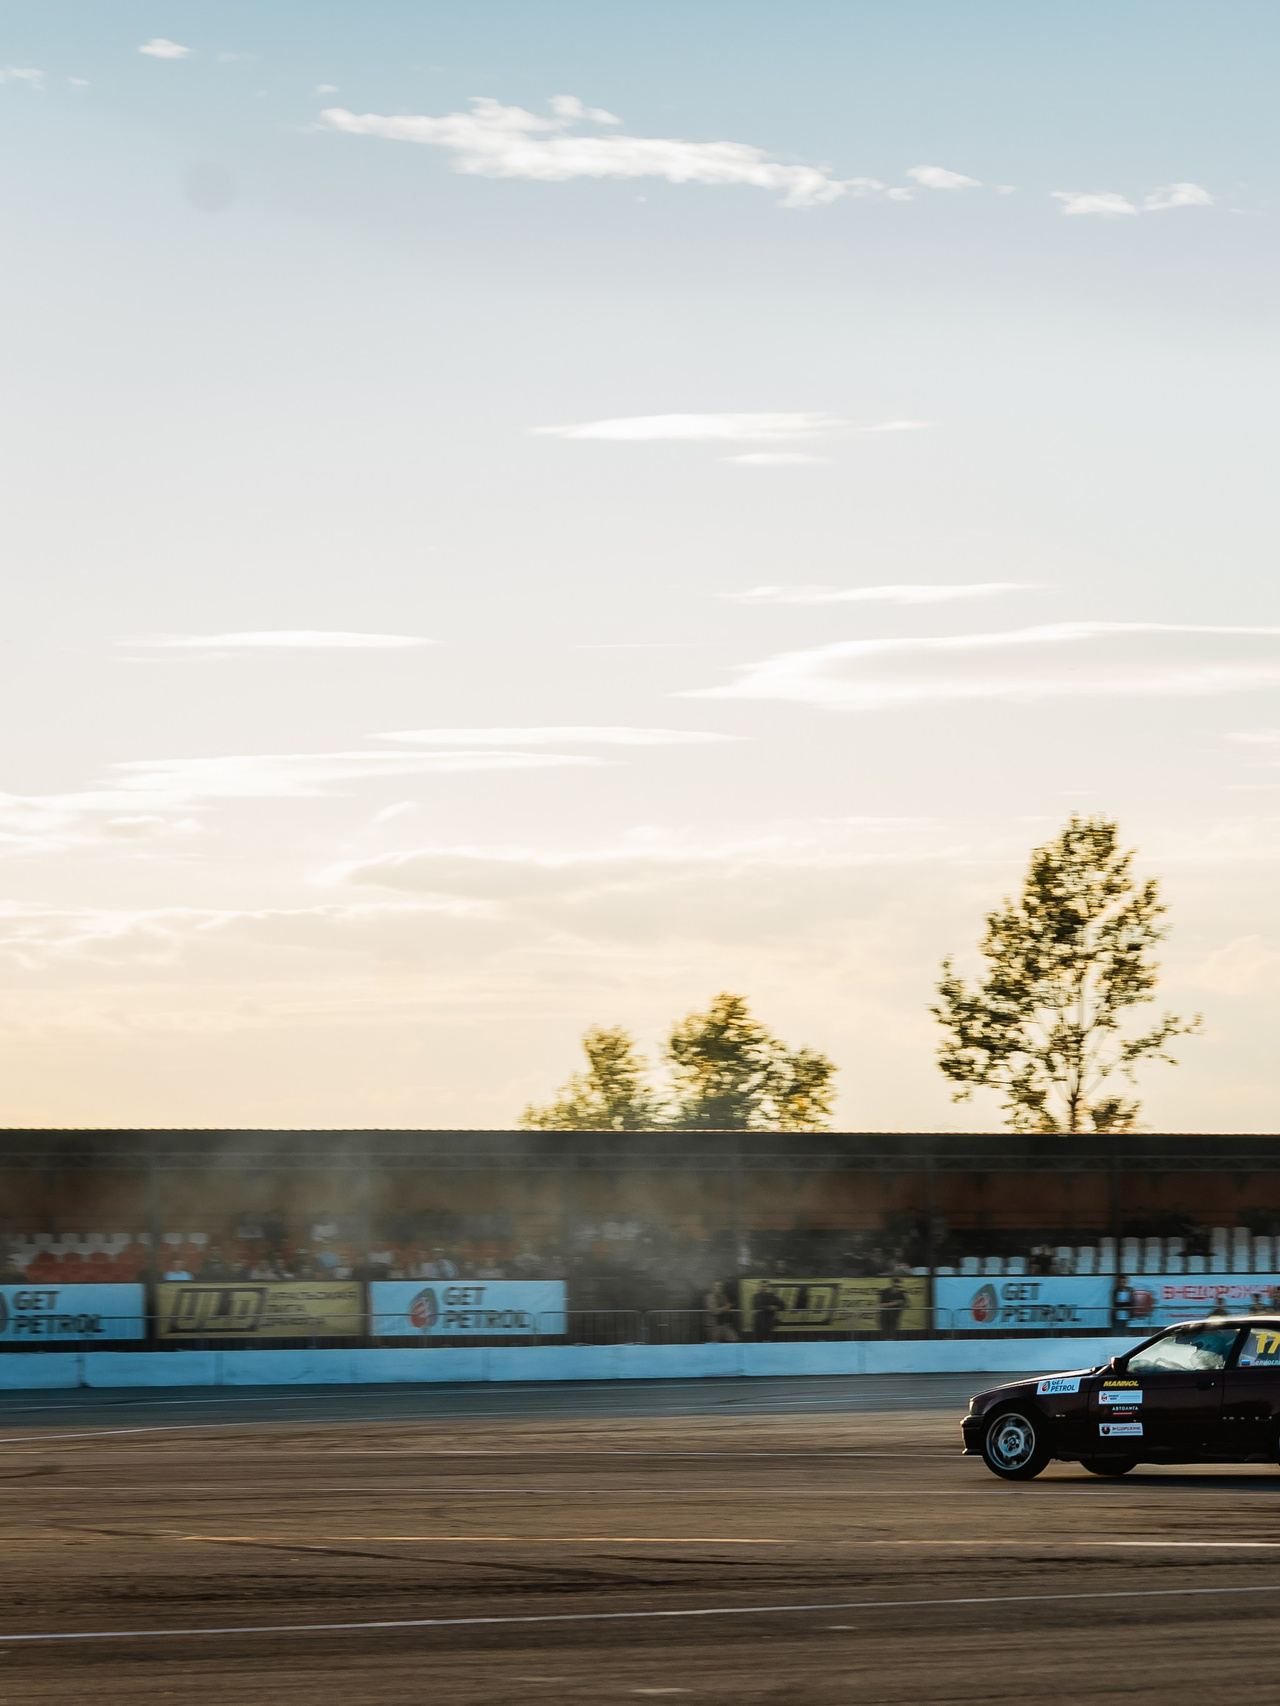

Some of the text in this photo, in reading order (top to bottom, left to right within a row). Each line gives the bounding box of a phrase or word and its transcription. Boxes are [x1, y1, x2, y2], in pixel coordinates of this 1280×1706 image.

[12, 1290, 60, 1310] GET
[443, 1286, 487, 1305] GET
[1002, 1282, 1043, 1300] GET
[442, 1310, 530, 1328] PETROL
[1001, 1304, 1082, 1322] PETROL
[12, 1313, 105, 1334] PETROL
